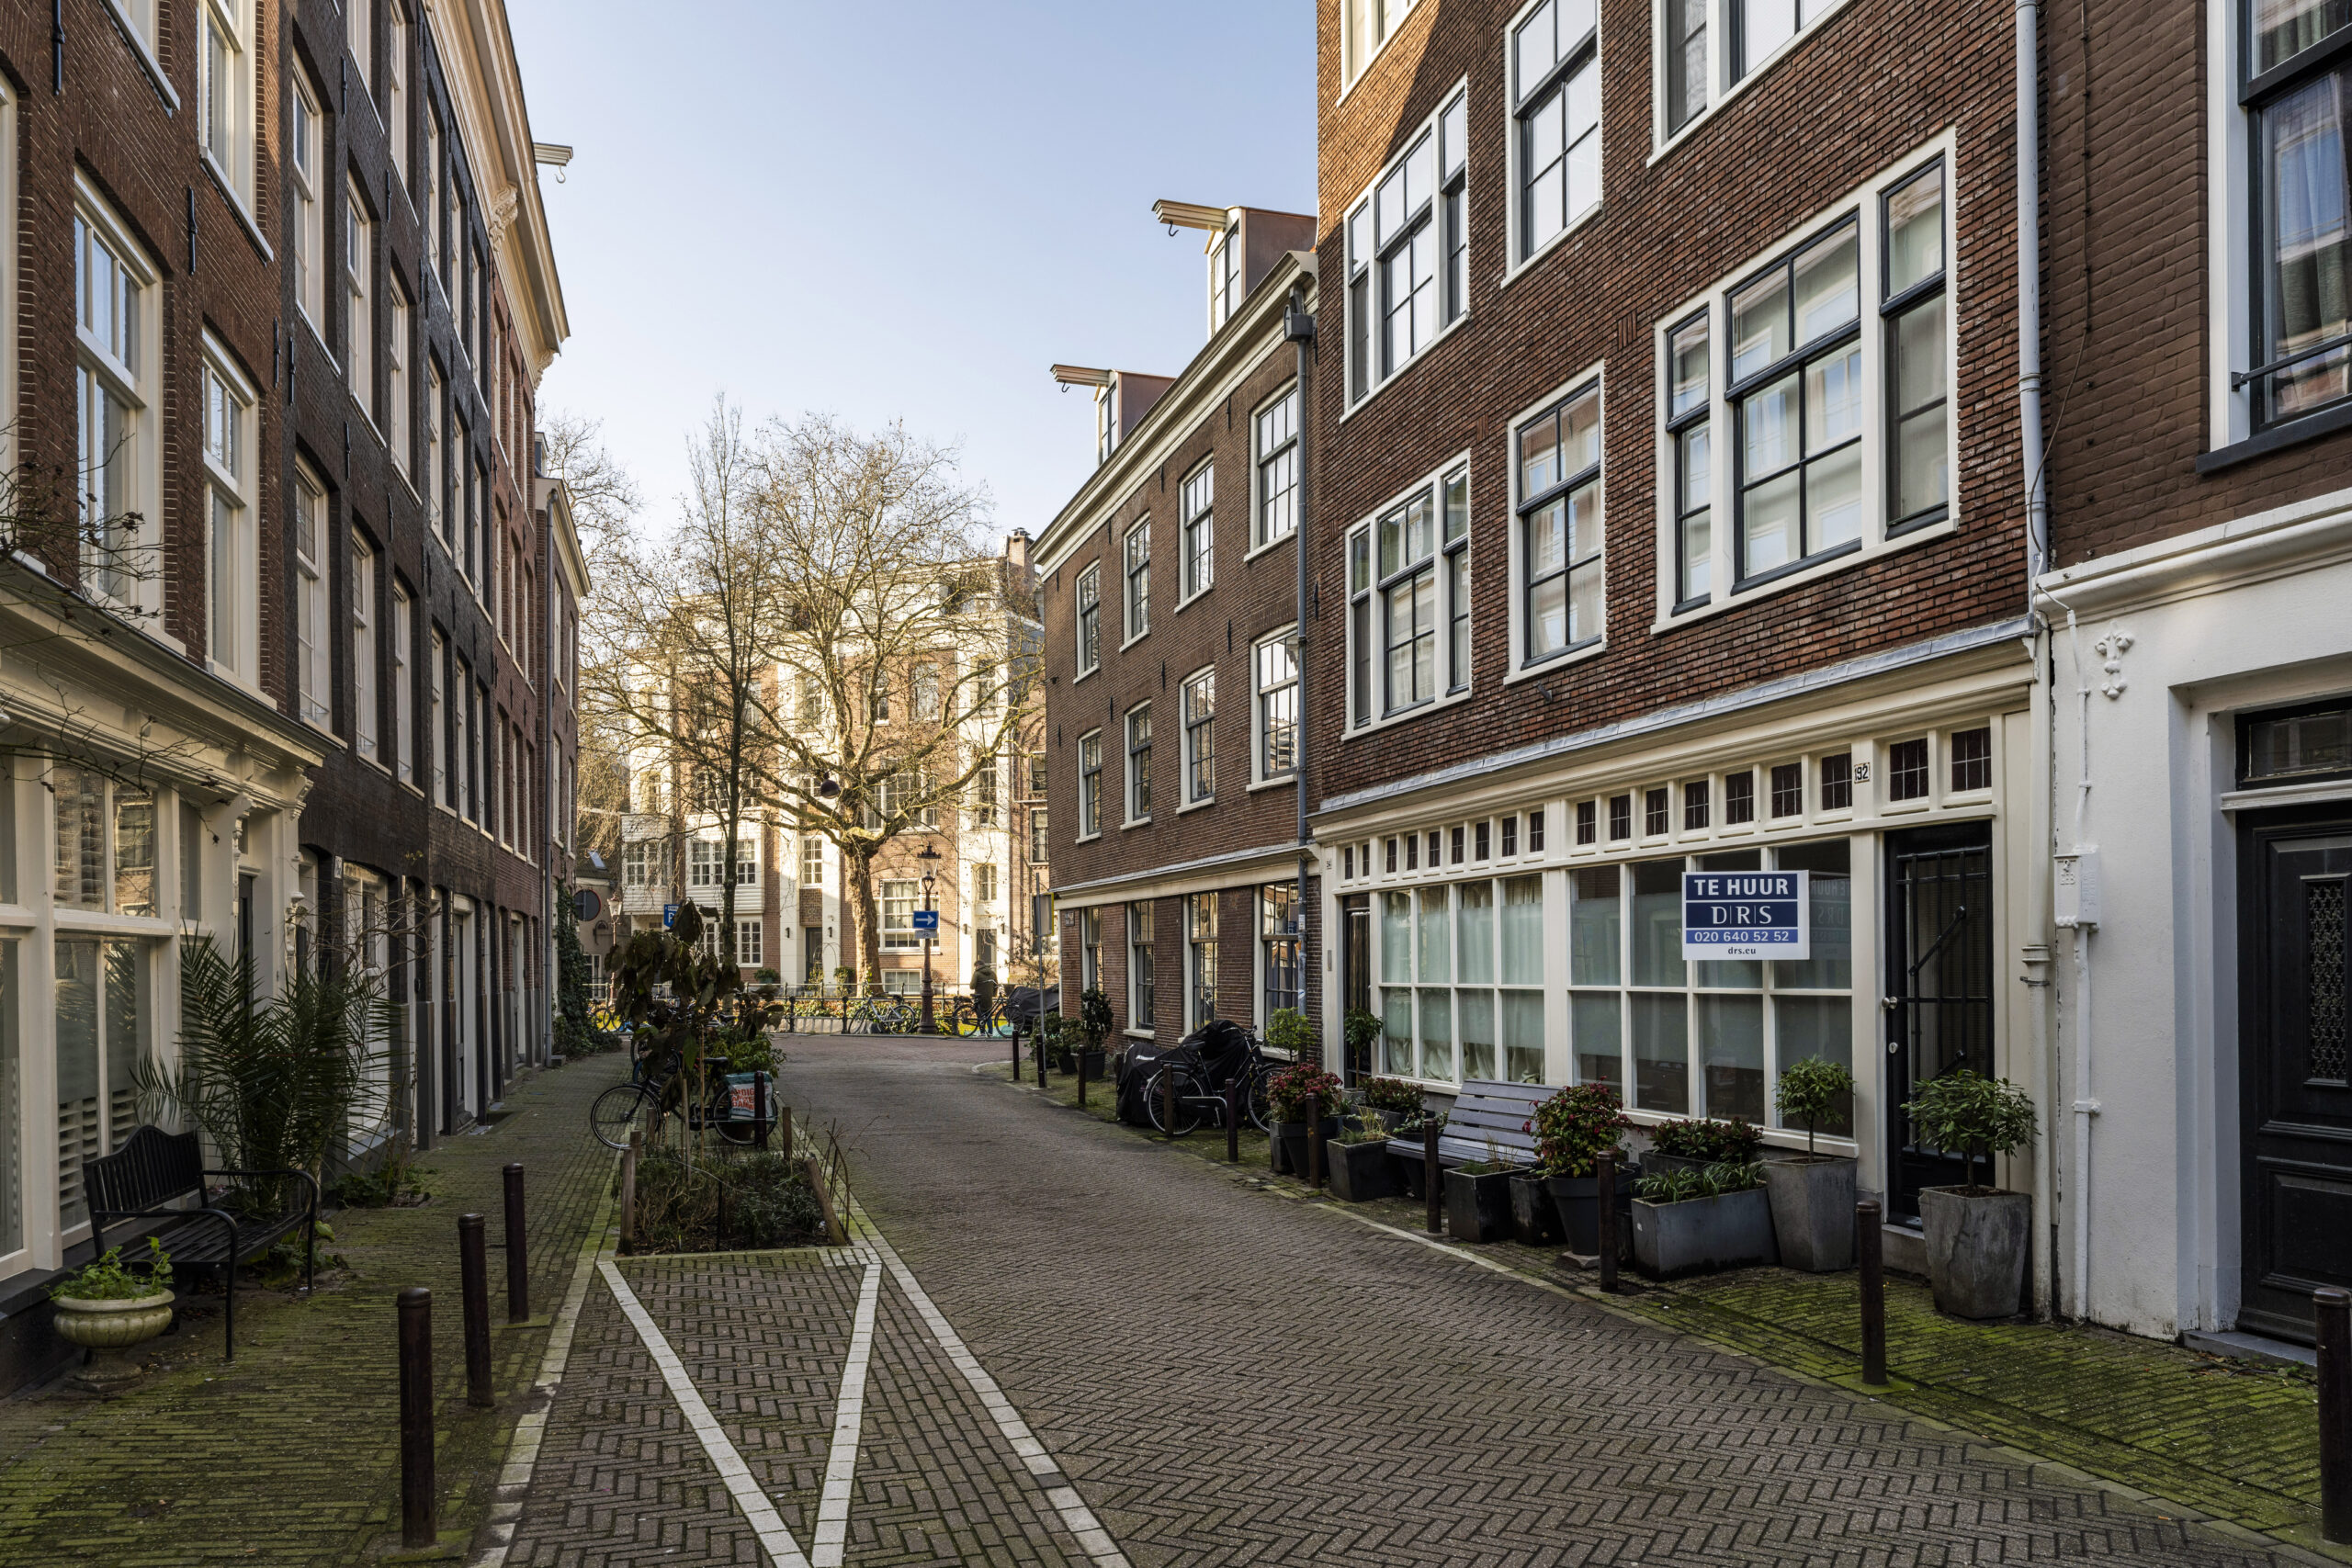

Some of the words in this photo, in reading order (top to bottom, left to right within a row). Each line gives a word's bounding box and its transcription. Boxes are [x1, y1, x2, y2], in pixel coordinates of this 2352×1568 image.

[1694, 879, 1719, 896] TE
[1727, 878, 1789, 896] HUUR
[1694, 931, 1719, 942] 020
[1723, 931, 1748, 942] 640
[1753, 931, 1769, 942] 52
[1773, 931, 1789, 942] 52
